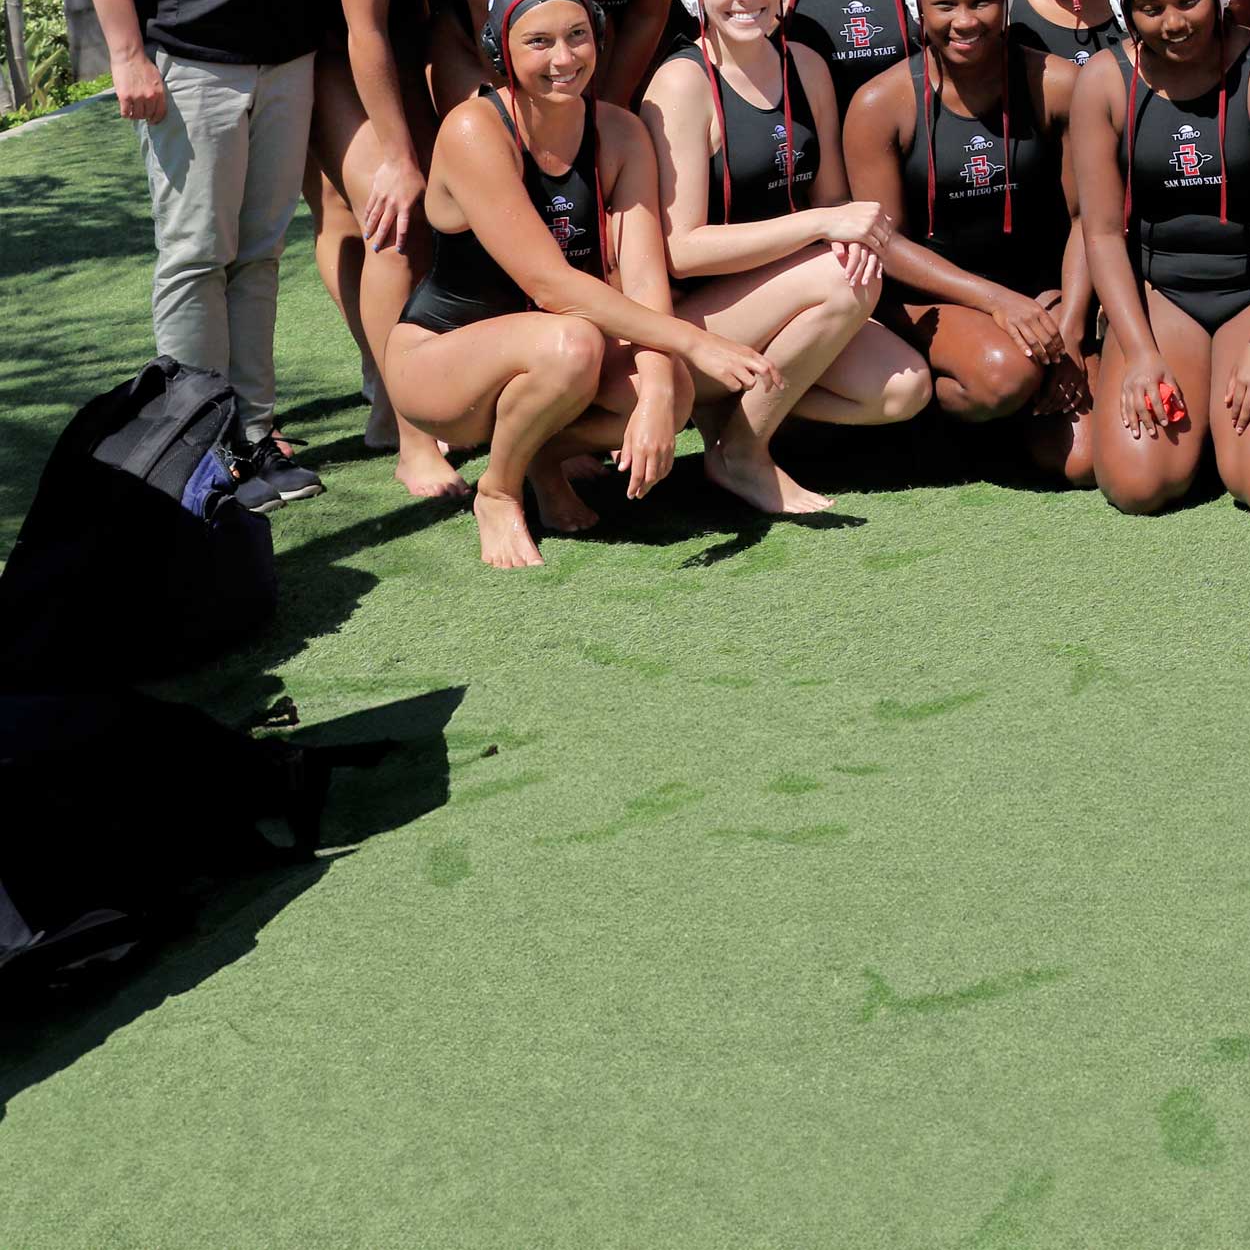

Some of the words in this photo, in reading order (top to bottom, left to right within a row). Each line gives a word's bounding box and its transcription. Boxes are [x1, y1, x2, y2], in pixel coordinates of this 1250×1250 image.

[841, 6, 872, 15] TURBO
[832, 52, 846, 61] SAN
[848, 48, 872, 59] DIEGO
[873, 46, 897, 57] STATE
[1171, 130, 1201, 141] TURBO
[963, 141, 994, 152] TURBO
[767, 181, 779, 190] SAN
[795, 171, 813, 184] STATE
[1164, 179, 1180, 188] SAN
[1181, 177, 1203, 187] DIEGO
[949, 190, 965, 199] SAN
[967, 186, 992, 197] DIEGO
[546, 202, 574, 212] TURBO
